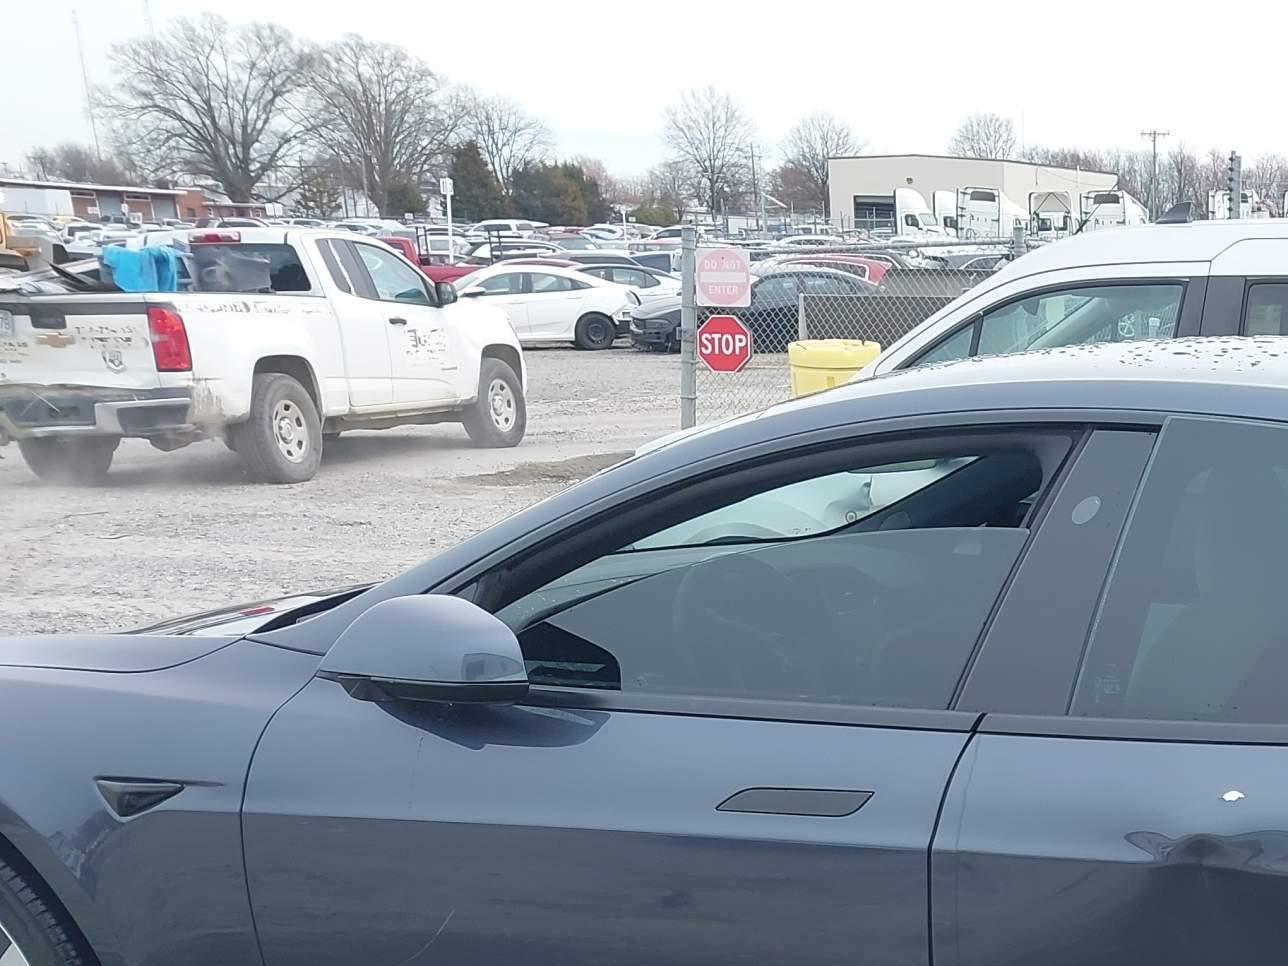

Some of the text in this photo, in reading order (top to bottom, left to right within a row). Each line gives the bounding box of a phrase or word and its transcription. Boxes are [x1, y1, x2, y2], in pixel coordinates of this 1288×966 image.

[704, 260, 741, 270] DO NOT
[708, 285, 739, 295] ENTER
[700, 333, 747, 355] STOP
